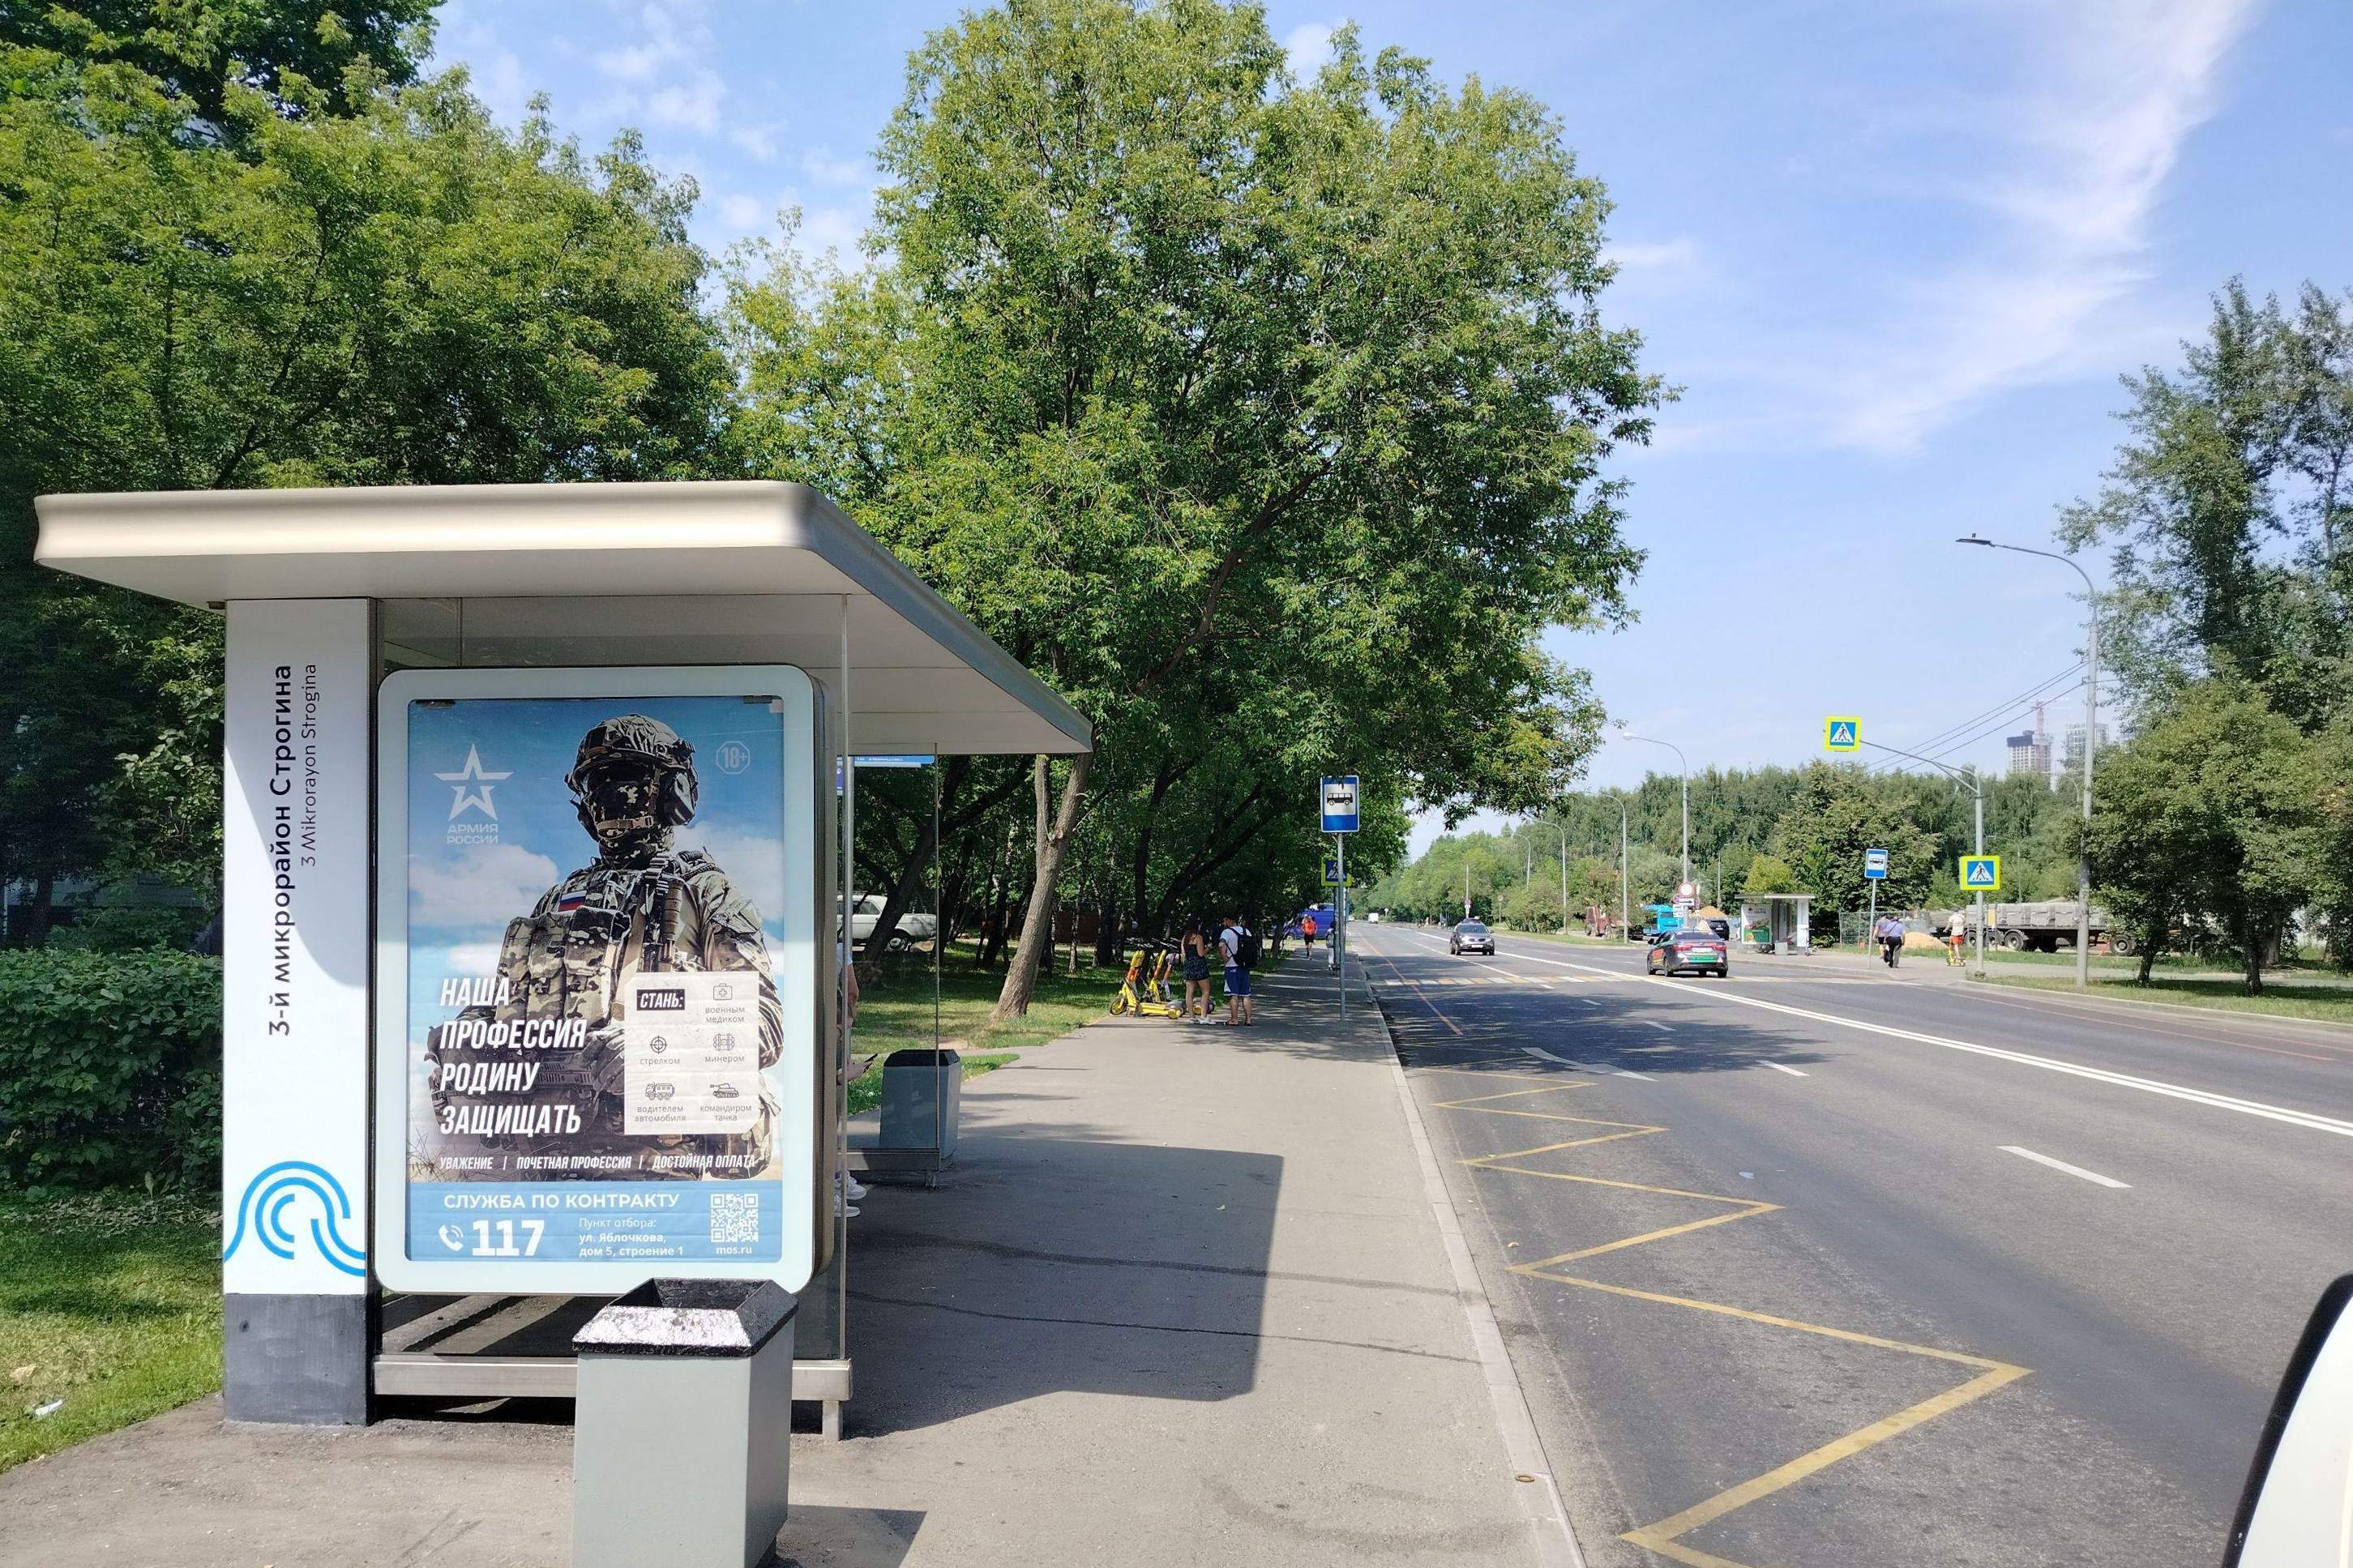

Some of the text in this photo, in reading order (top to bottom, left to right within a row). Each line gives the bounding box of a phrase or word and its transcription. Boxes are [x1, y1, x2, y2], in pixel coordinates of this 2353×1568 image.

[721, 746, 748, 769] 18+
[301, 663, 319, 867] 3 Mikrorayon Strogina
[447, 823, 498, 834] АРМИЯ
[447, 835, 498, 844] РОССИИ
[268, 664, 296, 1036] 3-й микрорайон Строгина
[440, 977, 510, 1006] НАША
[640, 993, 684, 1009] СТАНЬ:
[439, 1019, 587, 1049] ПРОФЕССИЯ
[640, 1057, 680, 1066] стрелком
[704, 1055, 745, 1063] минером
[439, 1062, 540, 1095] РОДИНУ
[636, 1104, 683, 1113] водителем
[700, 1104, 752, 1113] командиром
[439, 1104, 581, 1138] ЗАЩИЩАТЬ
[714, 1113, 738, 1122] танка
[439, 1154, 755, 1170] УВАЖЕНИЕ ПОЧЕТНАЯ ПРОФЕССИЯ ДОСТОЙНАЯ ОПЛАТА
[443, 1194, 680, 1209] СЛУЖБА ПО КОНТРАКТУ
[579, 1217, 657, 1230] Пункт отбора:
[472, 1219, 545, 1257] 117
[579, 1233, 667, 1244] ул. Яблочкова,
[579, 1246, 683, 1258] дом 5, строение 1
[716, 1245, 752, 1255] mos.ru
